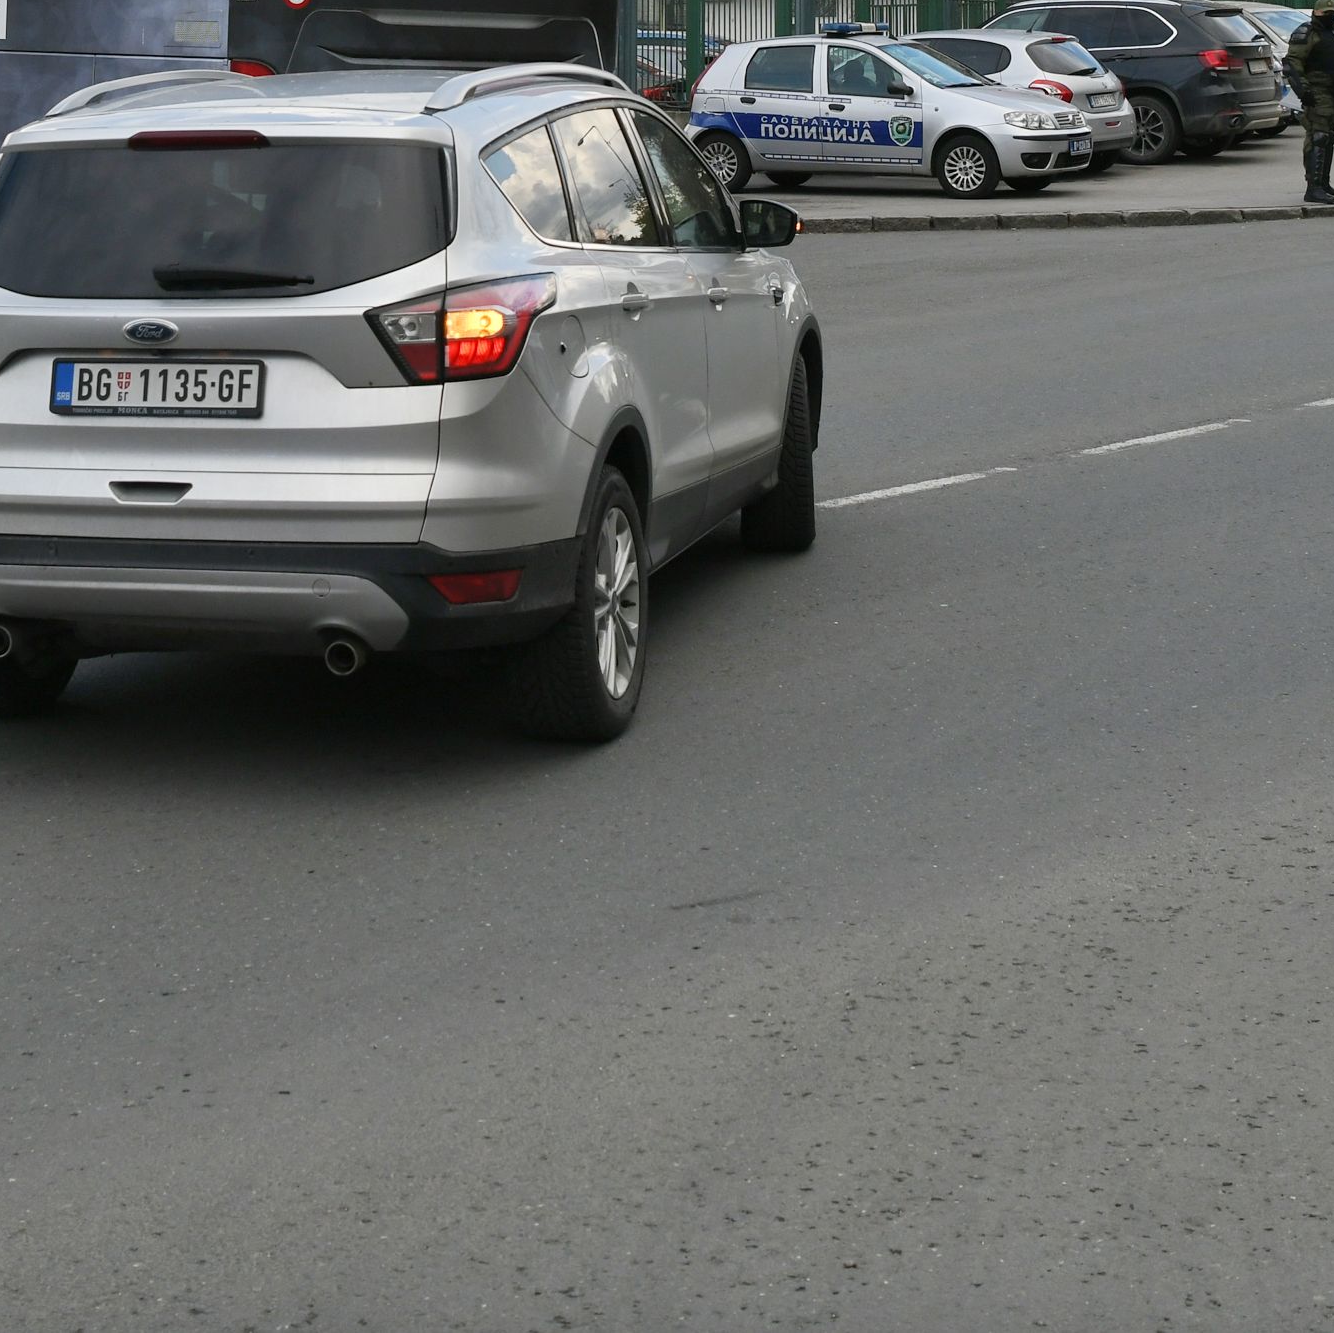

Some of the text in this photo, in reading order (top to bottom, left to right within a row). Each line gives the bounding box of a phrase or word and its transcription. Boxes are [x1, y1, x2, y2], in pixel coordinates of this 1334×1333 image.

[760, 116, 871, 129] САОБРАЋАЈНА
[761, 123, 875, 143] ПОЛИЦИЈА
[135, 324, 164, 338] Ford
[77, 367, 112, 401] BG
[56, 391, 70, 401] SRB
[117, 391, 129, 402] БГ
